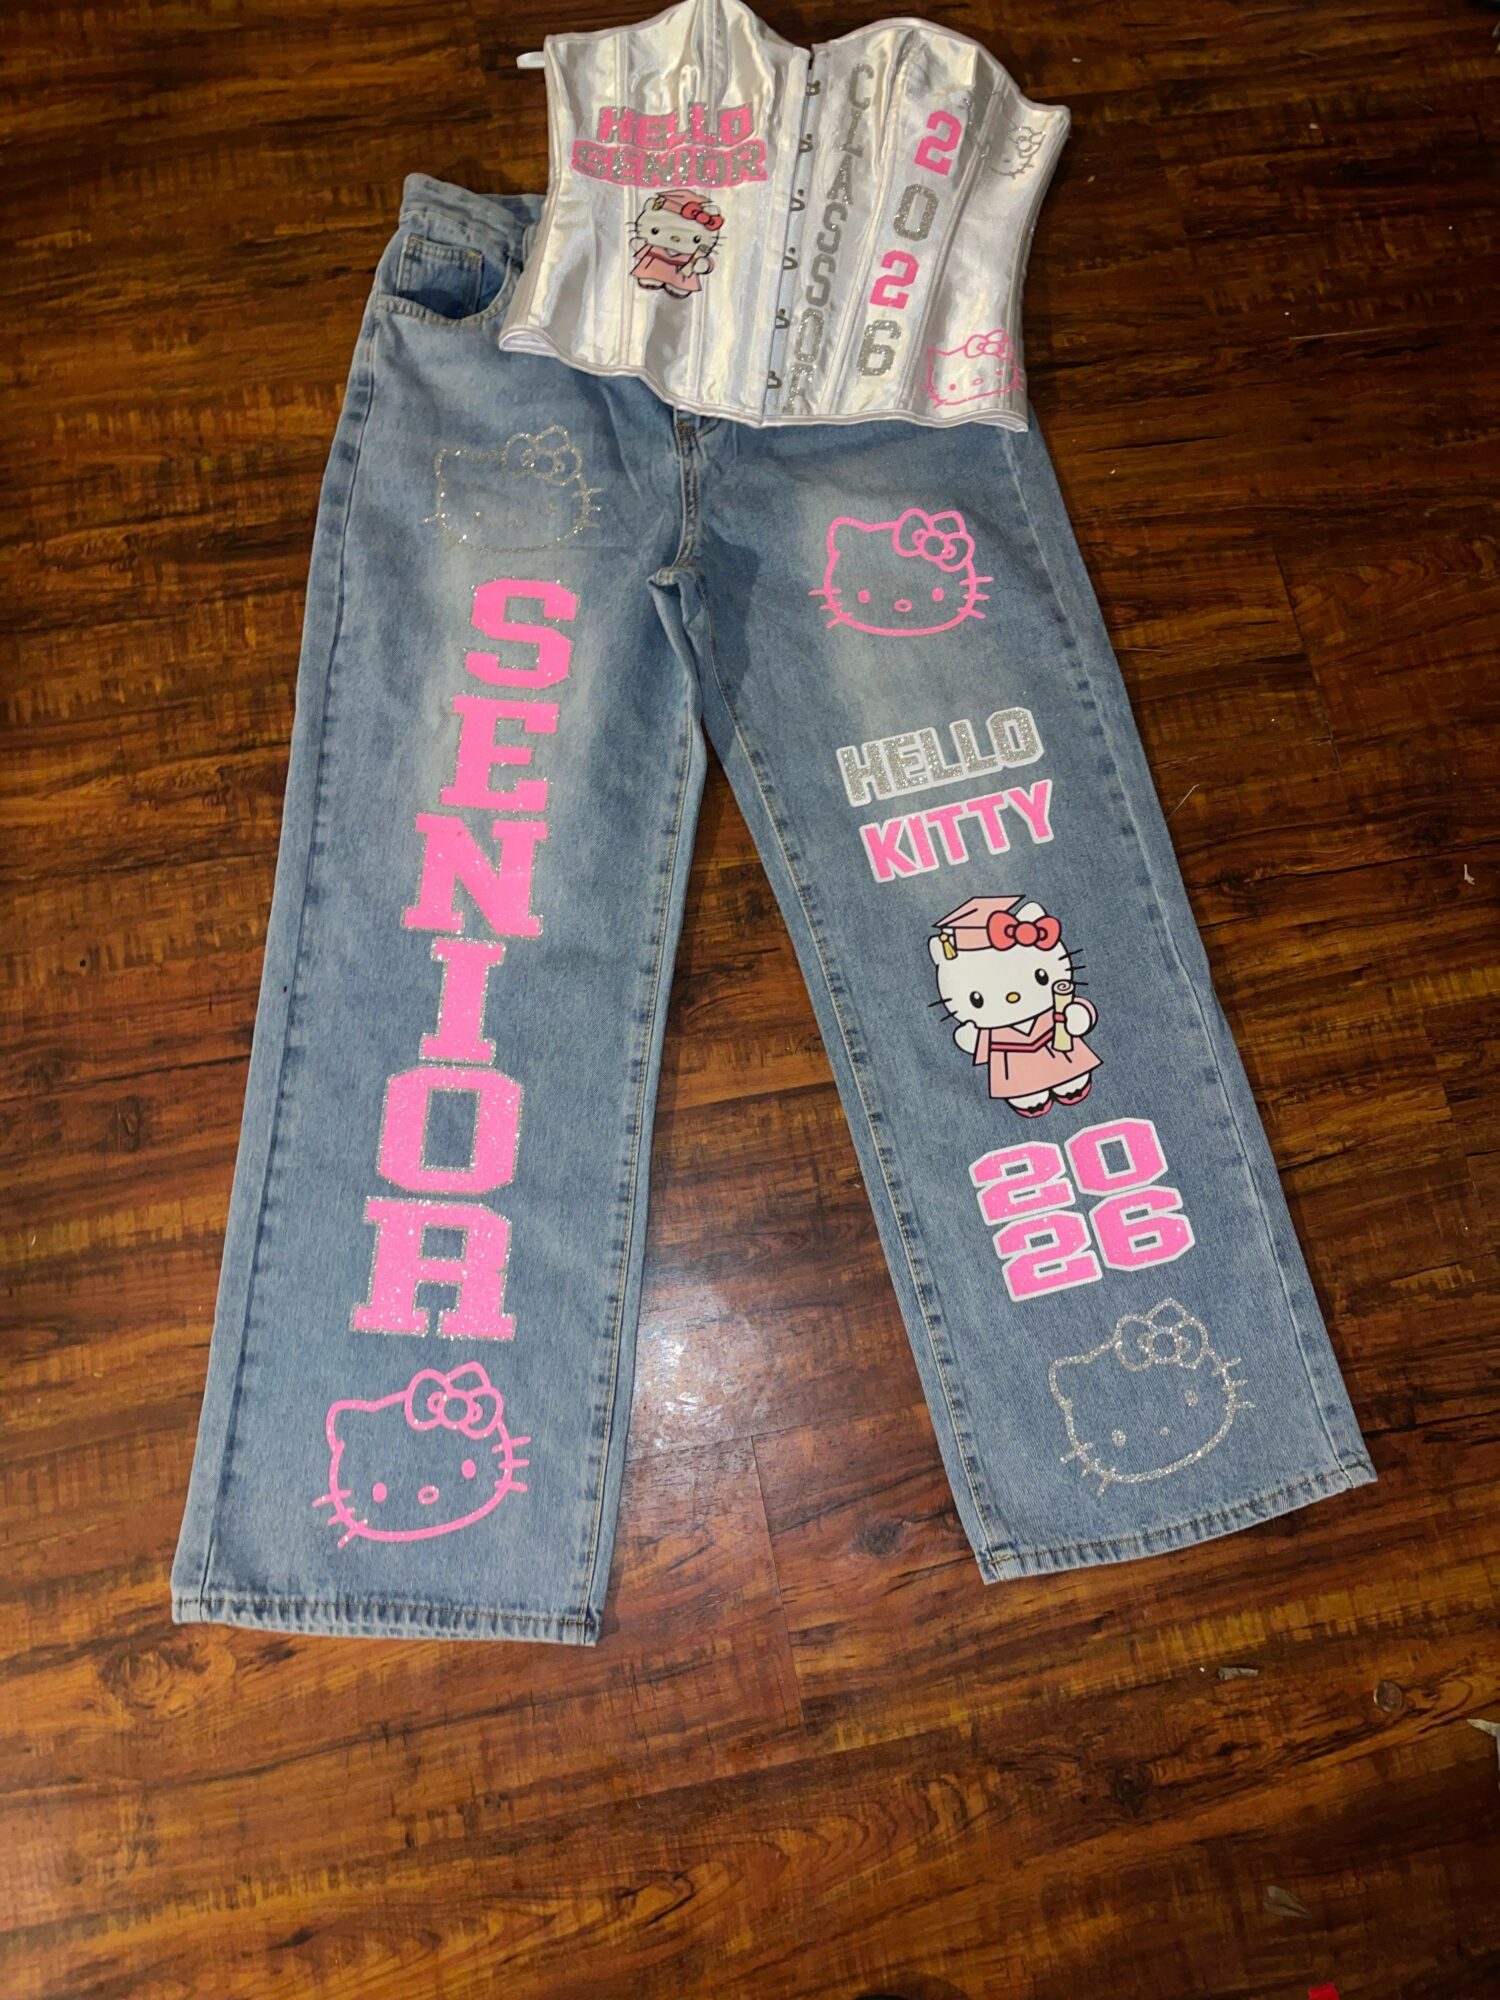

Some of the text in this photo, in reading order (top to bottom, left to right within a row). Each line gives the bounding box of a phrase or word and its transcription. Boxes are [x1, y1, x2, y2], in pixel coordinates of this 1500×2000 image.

[574, 141, 766, 187] SENIOR
[597, 102, 753, 150] HELLO
[806, 63, 874, 308] CLASS
[857, 110, 962, 376] 2026
[838, 708, 1043, 805] HELLO
[860, 780, 1052, 881] KITTY
[350, 577, 580, 1340] SENIOR
[969, 1118, 1168, 1225] 20
[993, 1186, 1194, 1299] 26
